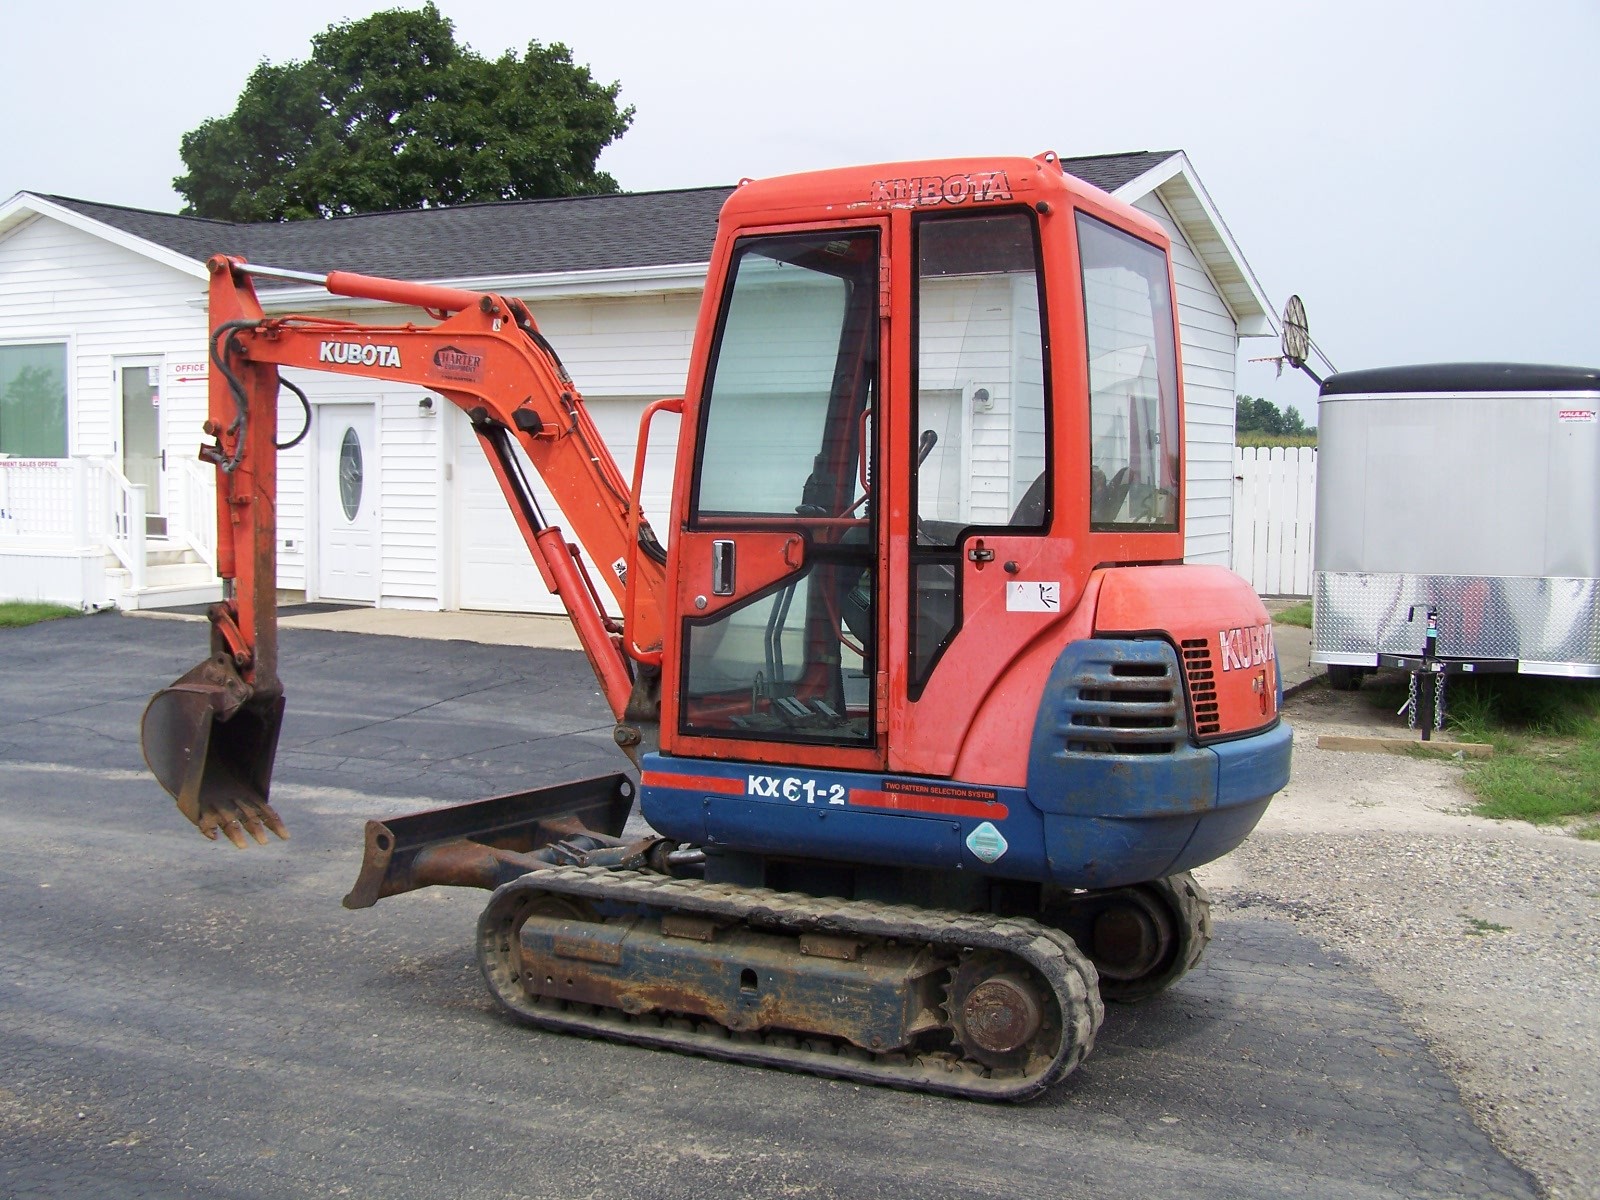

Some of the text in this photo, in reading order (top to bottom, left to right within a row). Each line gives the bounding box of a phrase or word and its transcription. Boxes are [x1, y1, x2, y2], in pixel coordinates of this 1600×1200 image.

[871, 170, 1014, 207] KUBOTA
[319, 340, 402, 368] KUBOTA
[441, 352, 481, 367] HARTER
[175, 363, 205, 372] OFFICE
[747, 774, 845, 806] KX61-2
[885, 782, 995, 799] TWO PATTERN SELECTION SYSTEM
